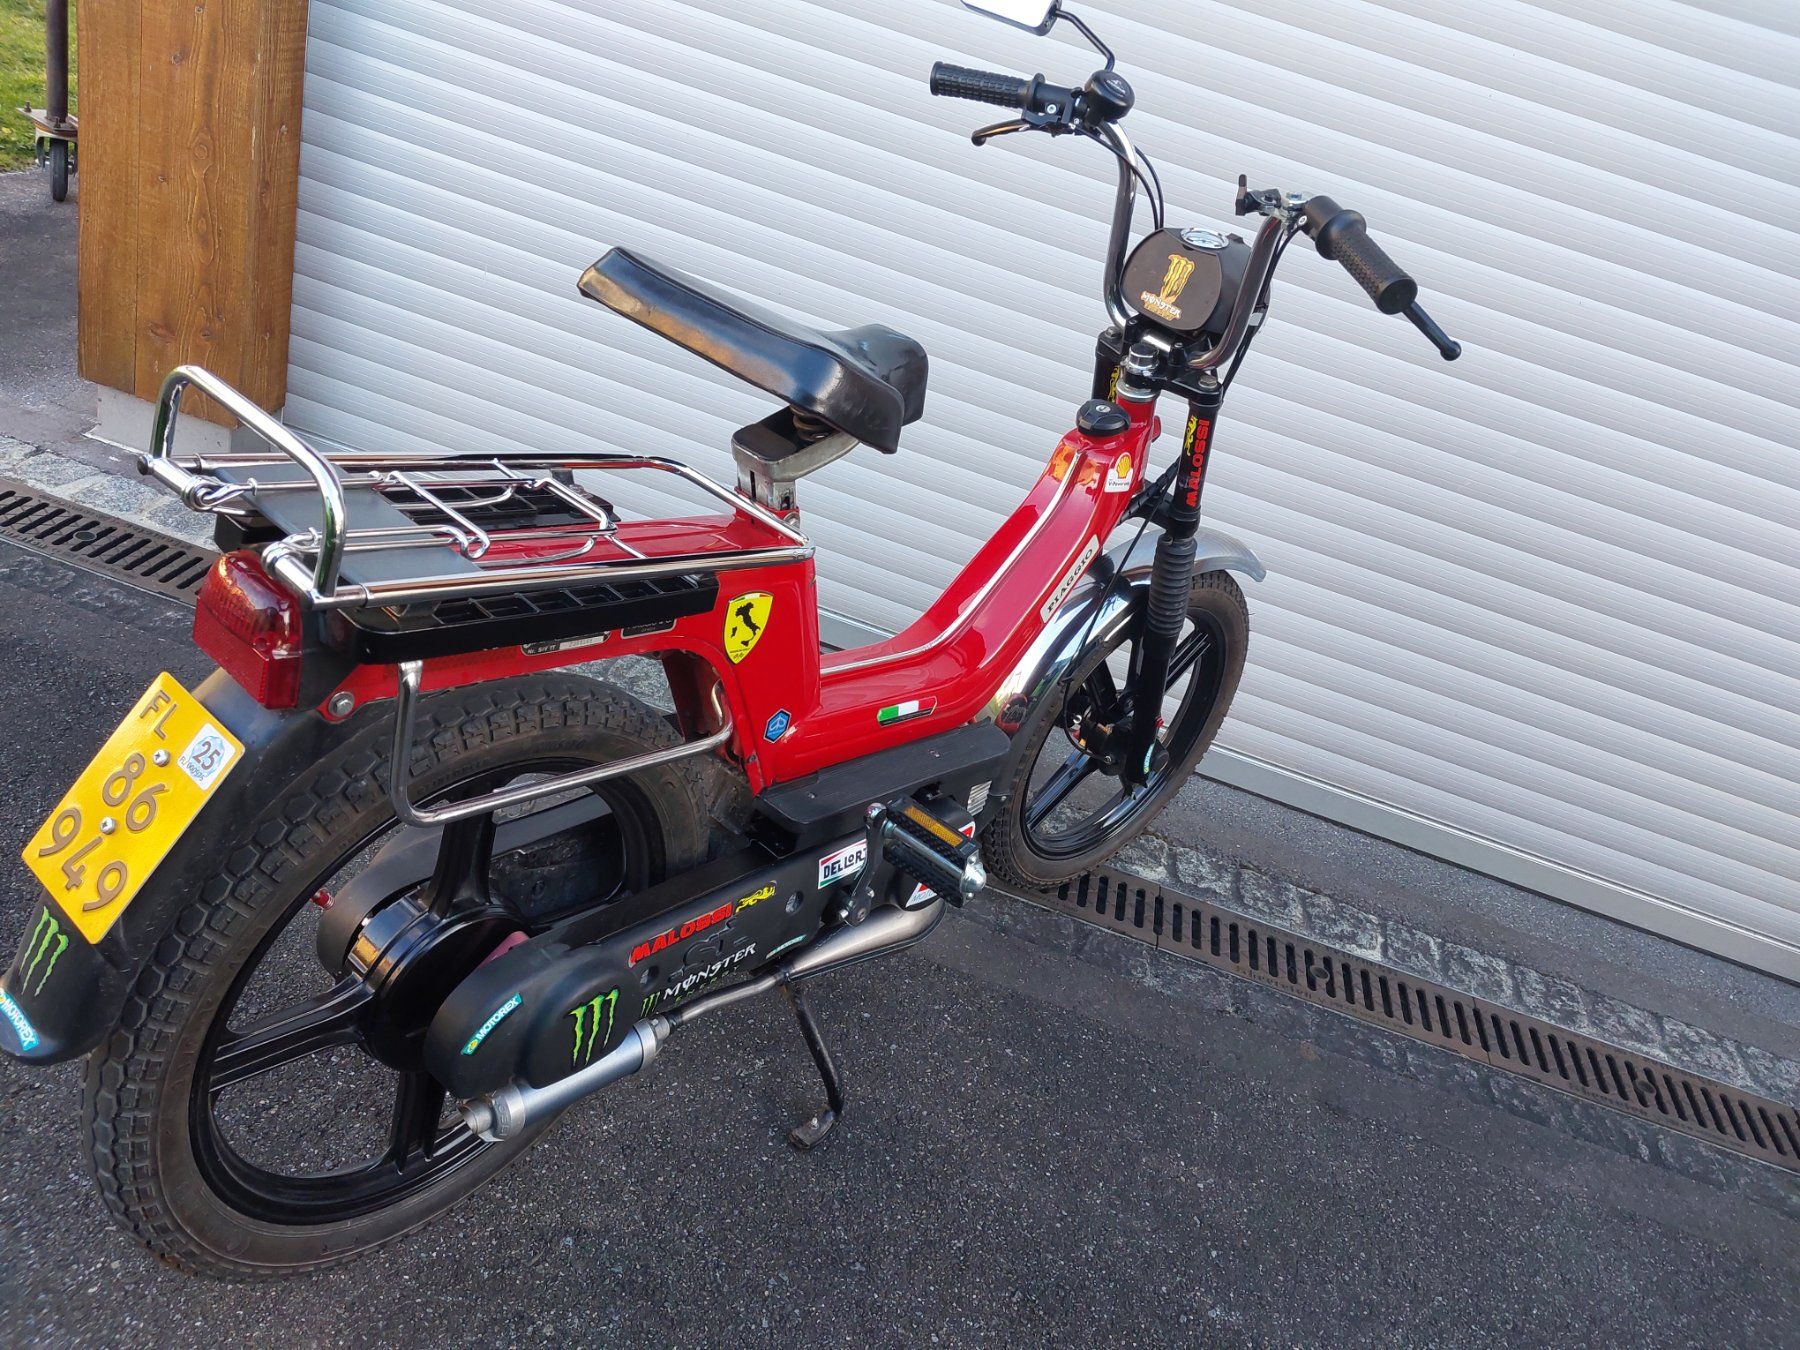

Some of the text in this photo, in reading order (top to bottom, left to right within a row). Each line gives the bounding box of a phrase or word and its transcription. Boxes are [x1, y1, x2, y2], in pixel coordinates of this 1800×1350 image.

[1185, 419, 1210, 507] MALOSSI
[1047, 548, 1093, 613] PIAGGIO
[139, 689, 177, 740] FL
[191, 739, 219, 771] 25
[101, 752, 169, 833] 86
[38, 806, 128, 912] 949
[629, 902, 733, 967] MALOSSI
[3, 992, 37, 1050] MOTOREX
[475, 996, 521, 1041] MOTOREX
